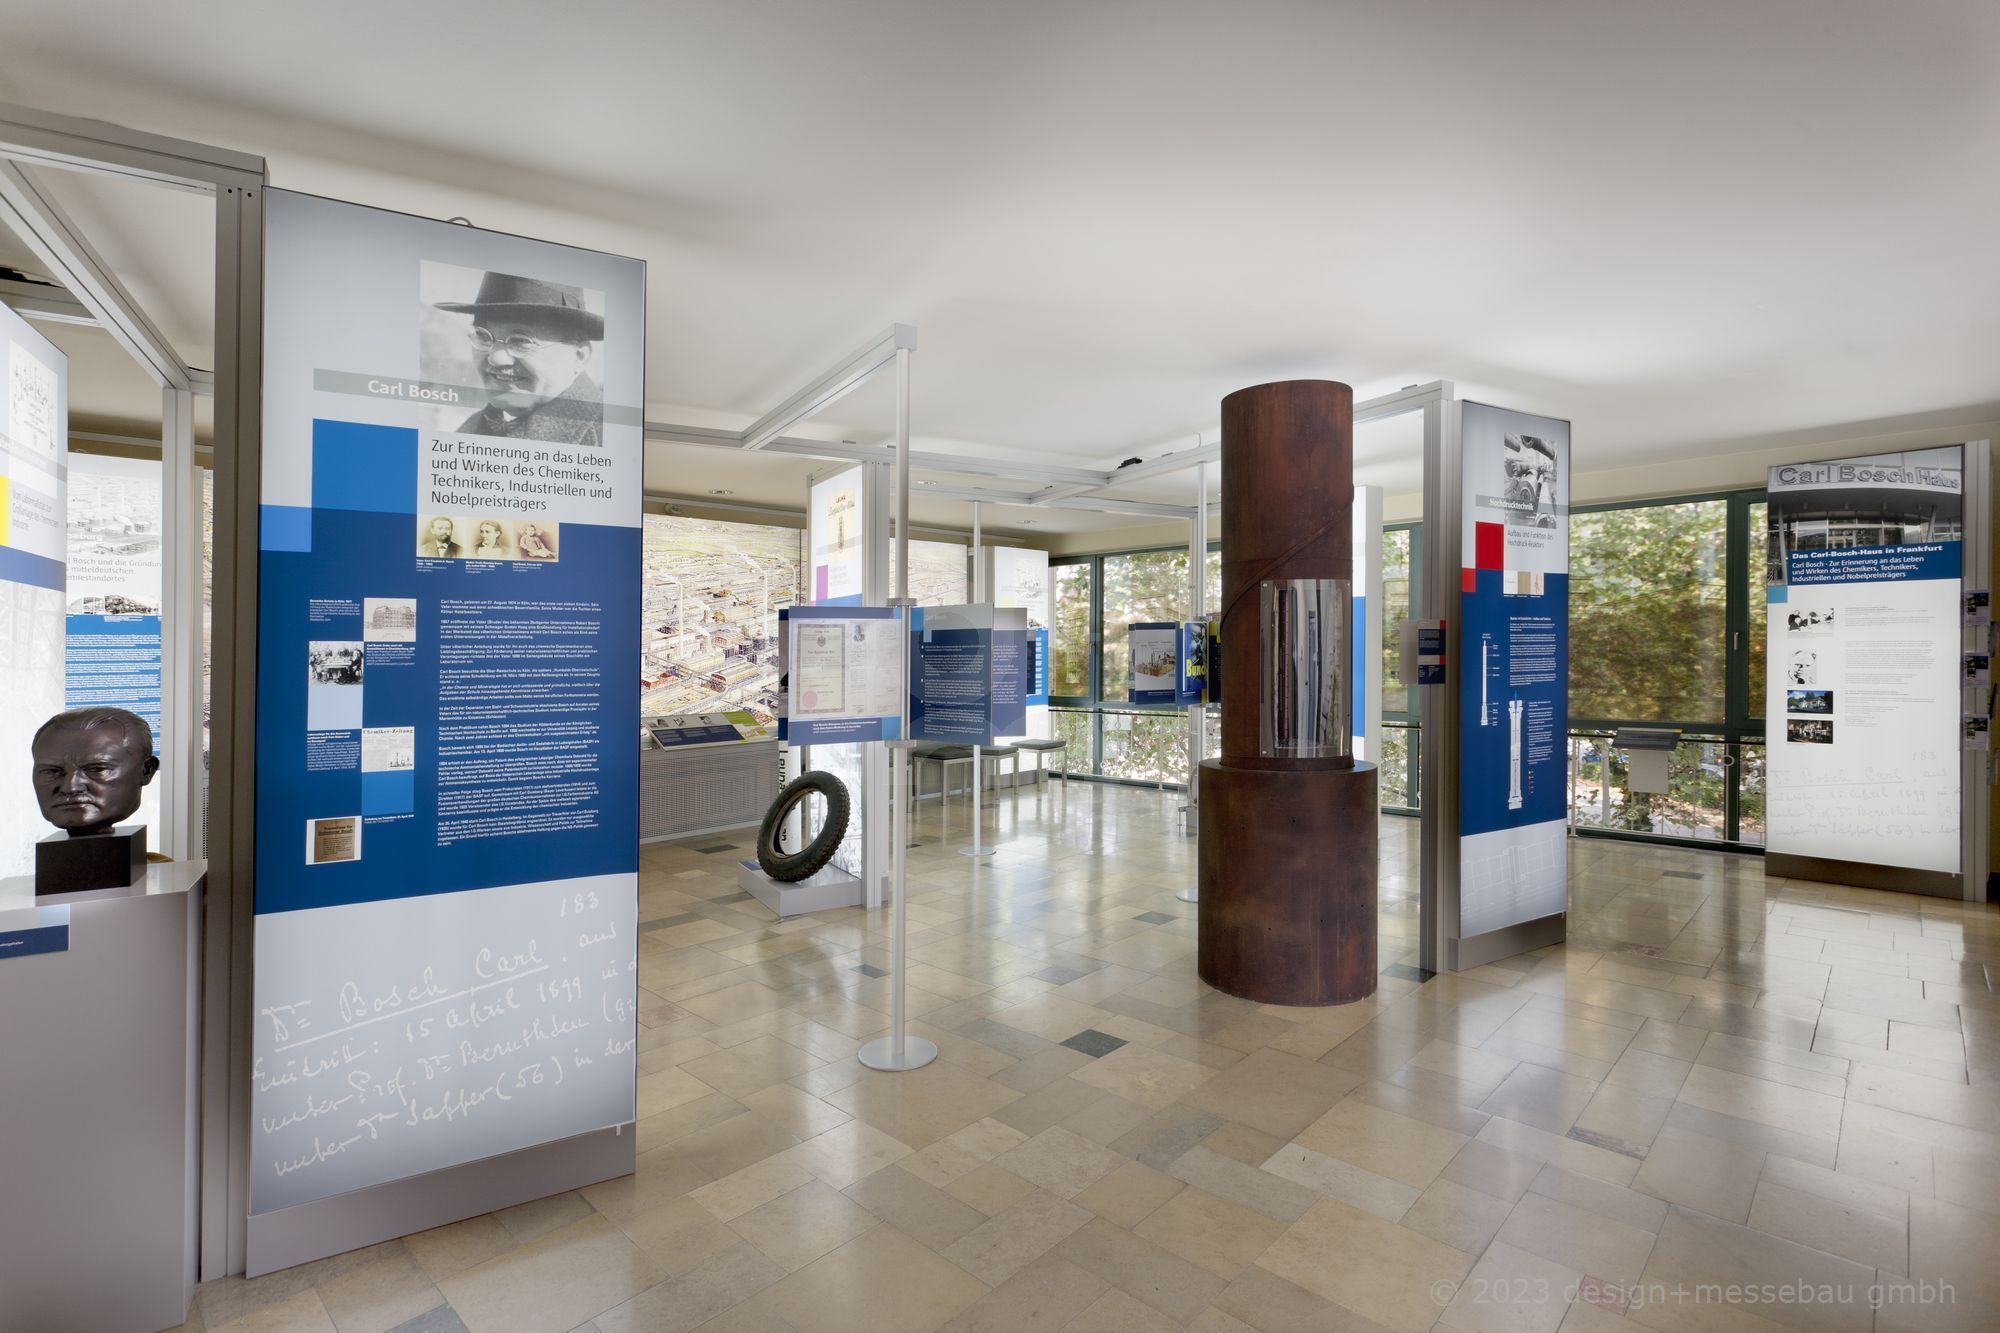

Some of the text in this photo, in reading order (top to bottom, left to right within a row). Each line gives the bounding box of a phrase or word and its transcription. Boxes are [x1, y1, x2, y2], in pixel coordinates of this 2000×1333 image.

[368, 379, 459, 403] Carl Bosch
[432, 439, 612, 468] Zur Erinnerung an das Leben
[431, 458, 604, 484] und Wirken des Chemikers,
[1778, 466, 1960, 488] Carl Bosch Haus
[432, 474, 612, 499] Technikers, Industriellen und
[432, 491, 546, 512] Nobelpreisträgers
[1490, 498, 1534, 511] Hochdrucktechnik
[1810, 548, 1882, 558] Carl-Bosch-Haus
[1897, 545, 1942, 554] Frankfurt
[1841, 558, 1878, 568] Erinnerung
[1792, 574, 1831, 582] Industriellen
[1847, 571, 1906, 581] Nobelpreisträgers
[560, 891, 599, 918] 183
[338, 967, 448, 1023] Bosch
[406, 1018, 434, 1044] 15
